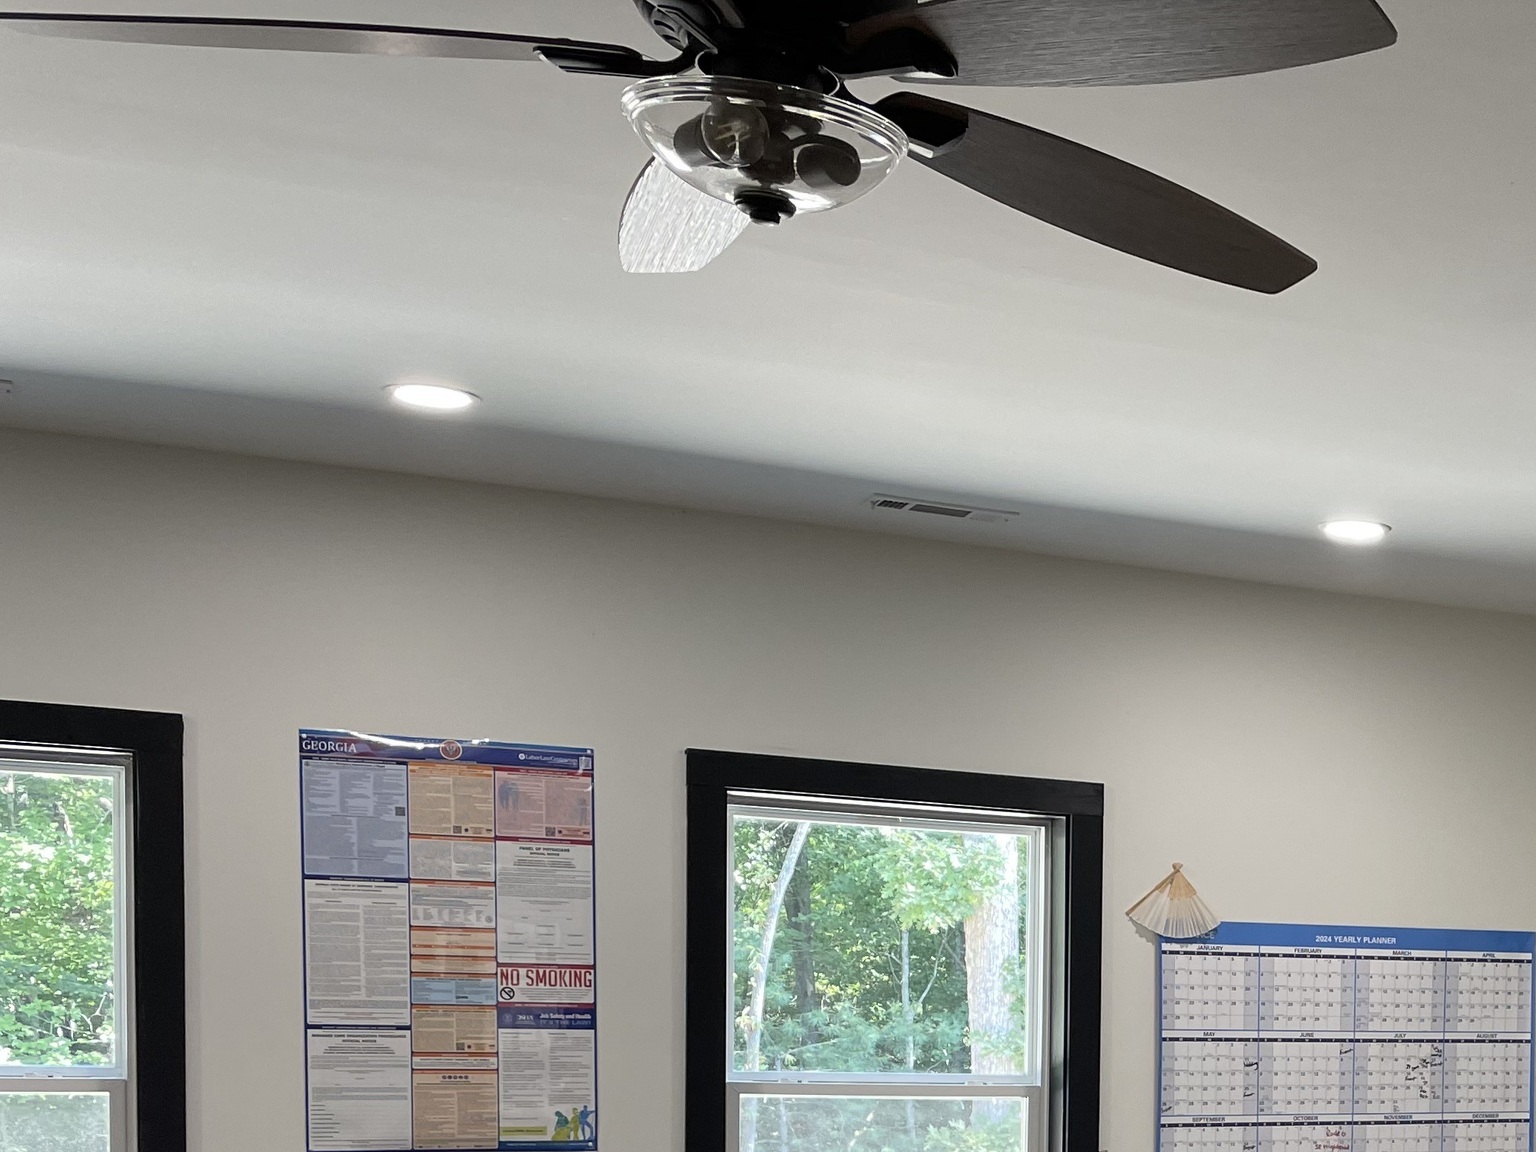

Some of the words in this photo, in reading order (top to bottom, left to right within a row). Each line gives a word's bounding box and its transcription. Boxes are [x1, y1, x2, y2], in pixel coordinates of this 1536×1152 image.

[302, 740, 357, 752] GEORGIA
[1334, 935, 1362, 944] YEARLY
[500, 969, 520, 986] NO
[526, 969, 592, 987] SMOKING
